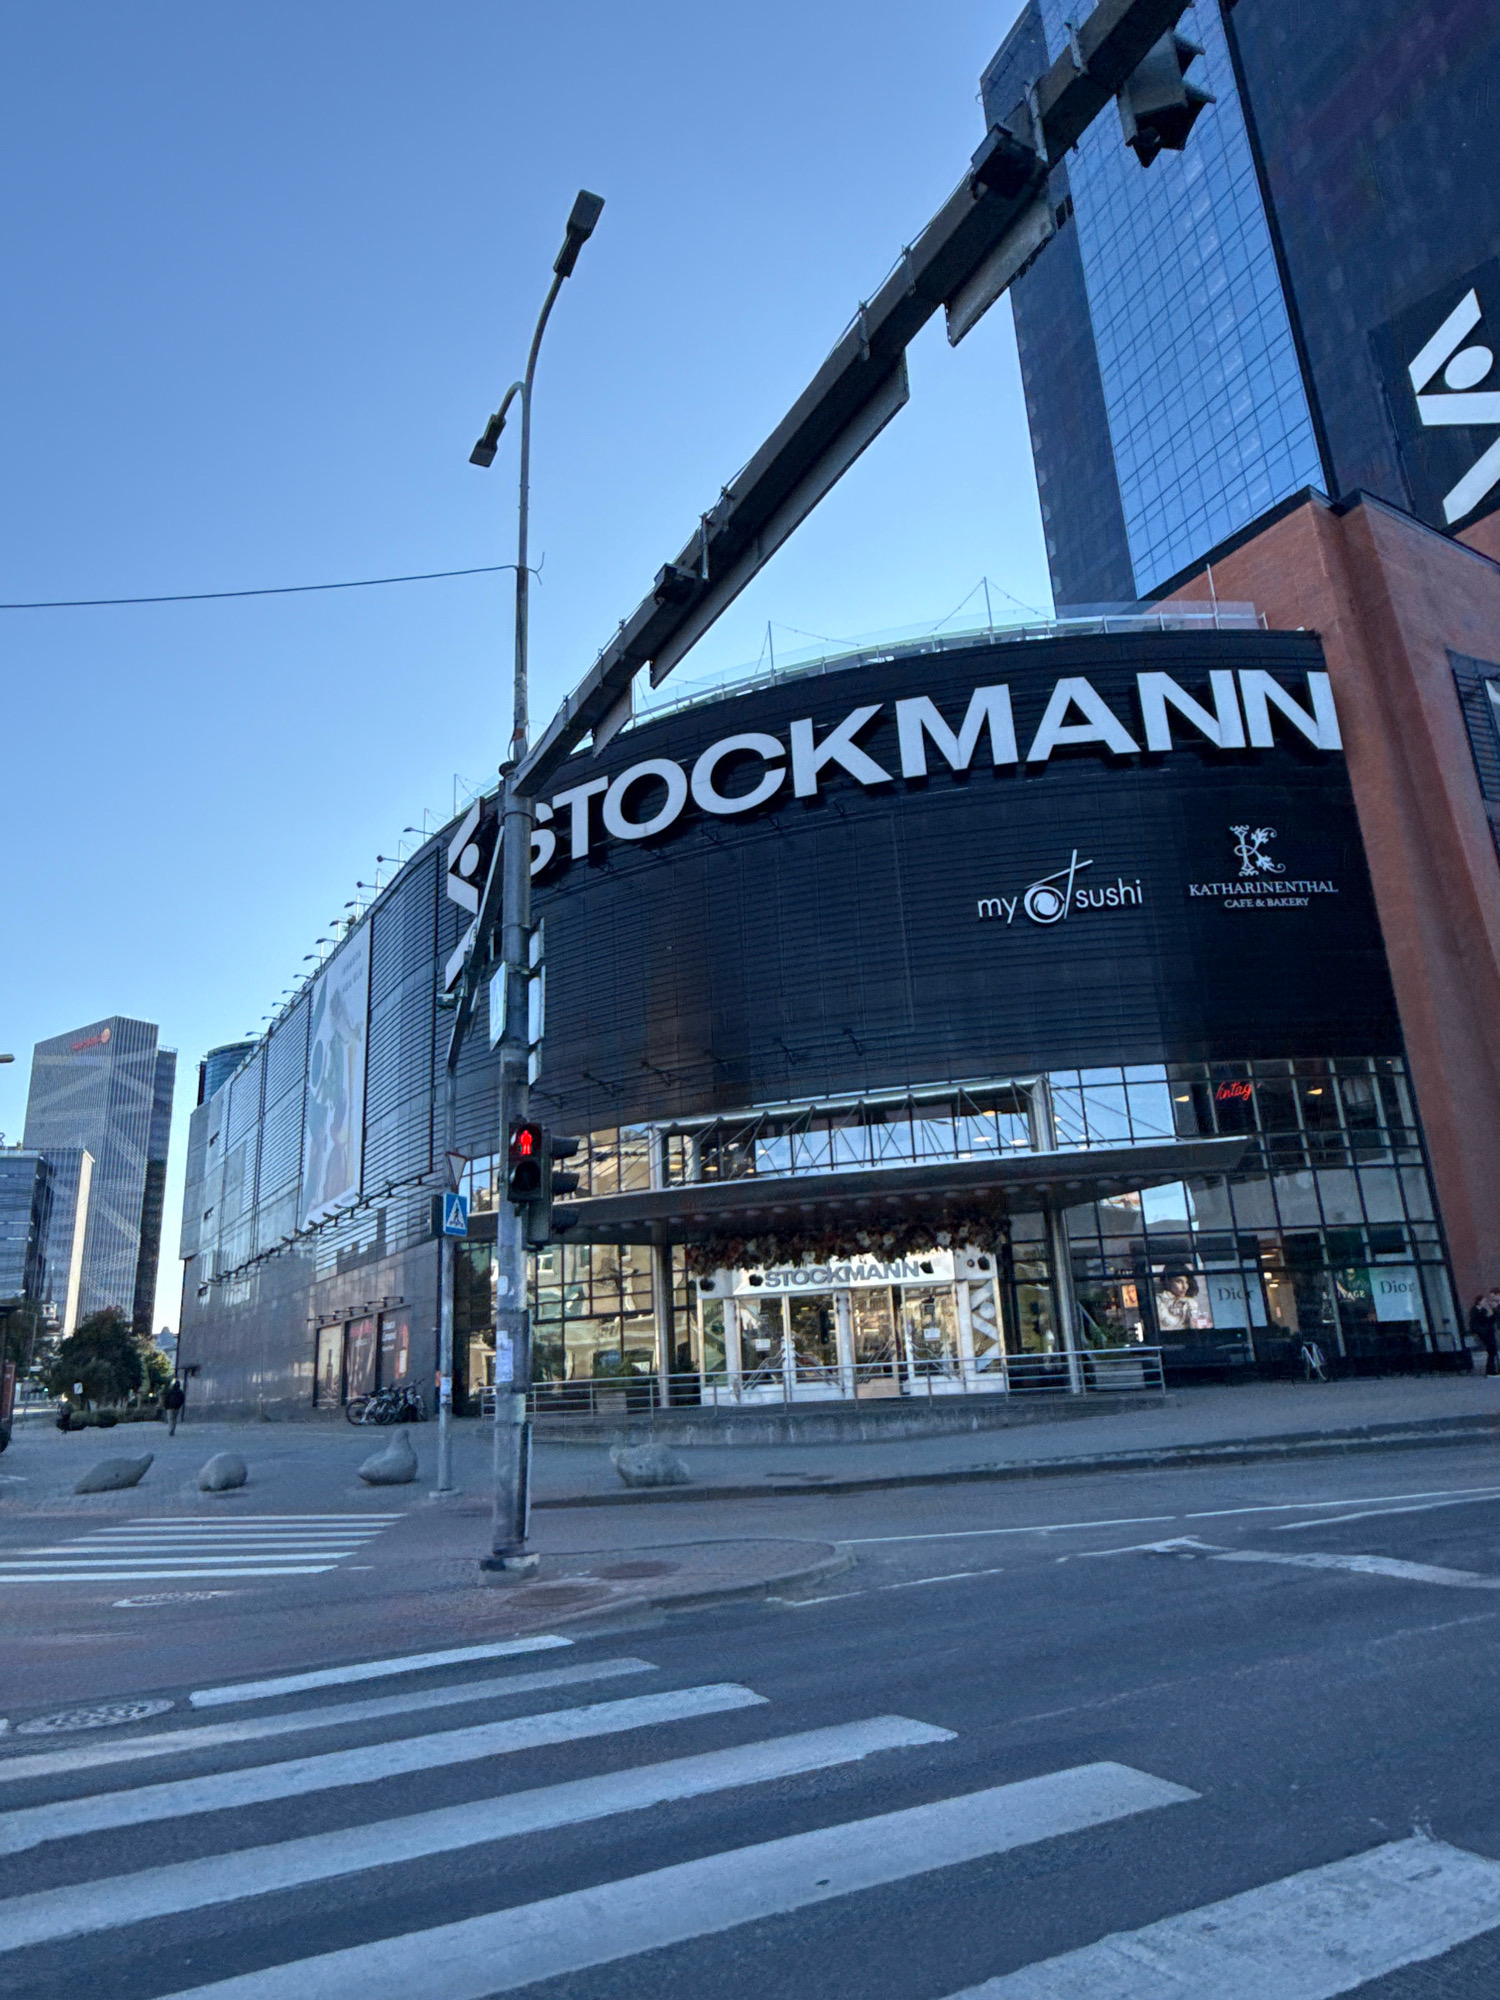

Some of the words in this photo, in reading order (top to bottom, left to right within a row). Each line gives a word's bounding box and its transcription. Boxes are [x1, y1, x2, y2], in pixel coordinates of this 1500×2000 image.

[530, 668, 1343, 877] STOCKMANN
[1189, 880, 1339, 896] KATHARINENTHAL
[977, 896, 1018, 925] my
[1075, 878, 1143, 908] sushi
[1224, 898, 1254, 908] CAFE
[1256, 898, 1265, 907] &
[1267, 898, 1309, 907] BAKERY
[764, 1260, 920, 1288] STOCKMANN
[1322, 1289, 1366, 1300] SVAGE
[1380, 1280, 1415, 1295] Dior
